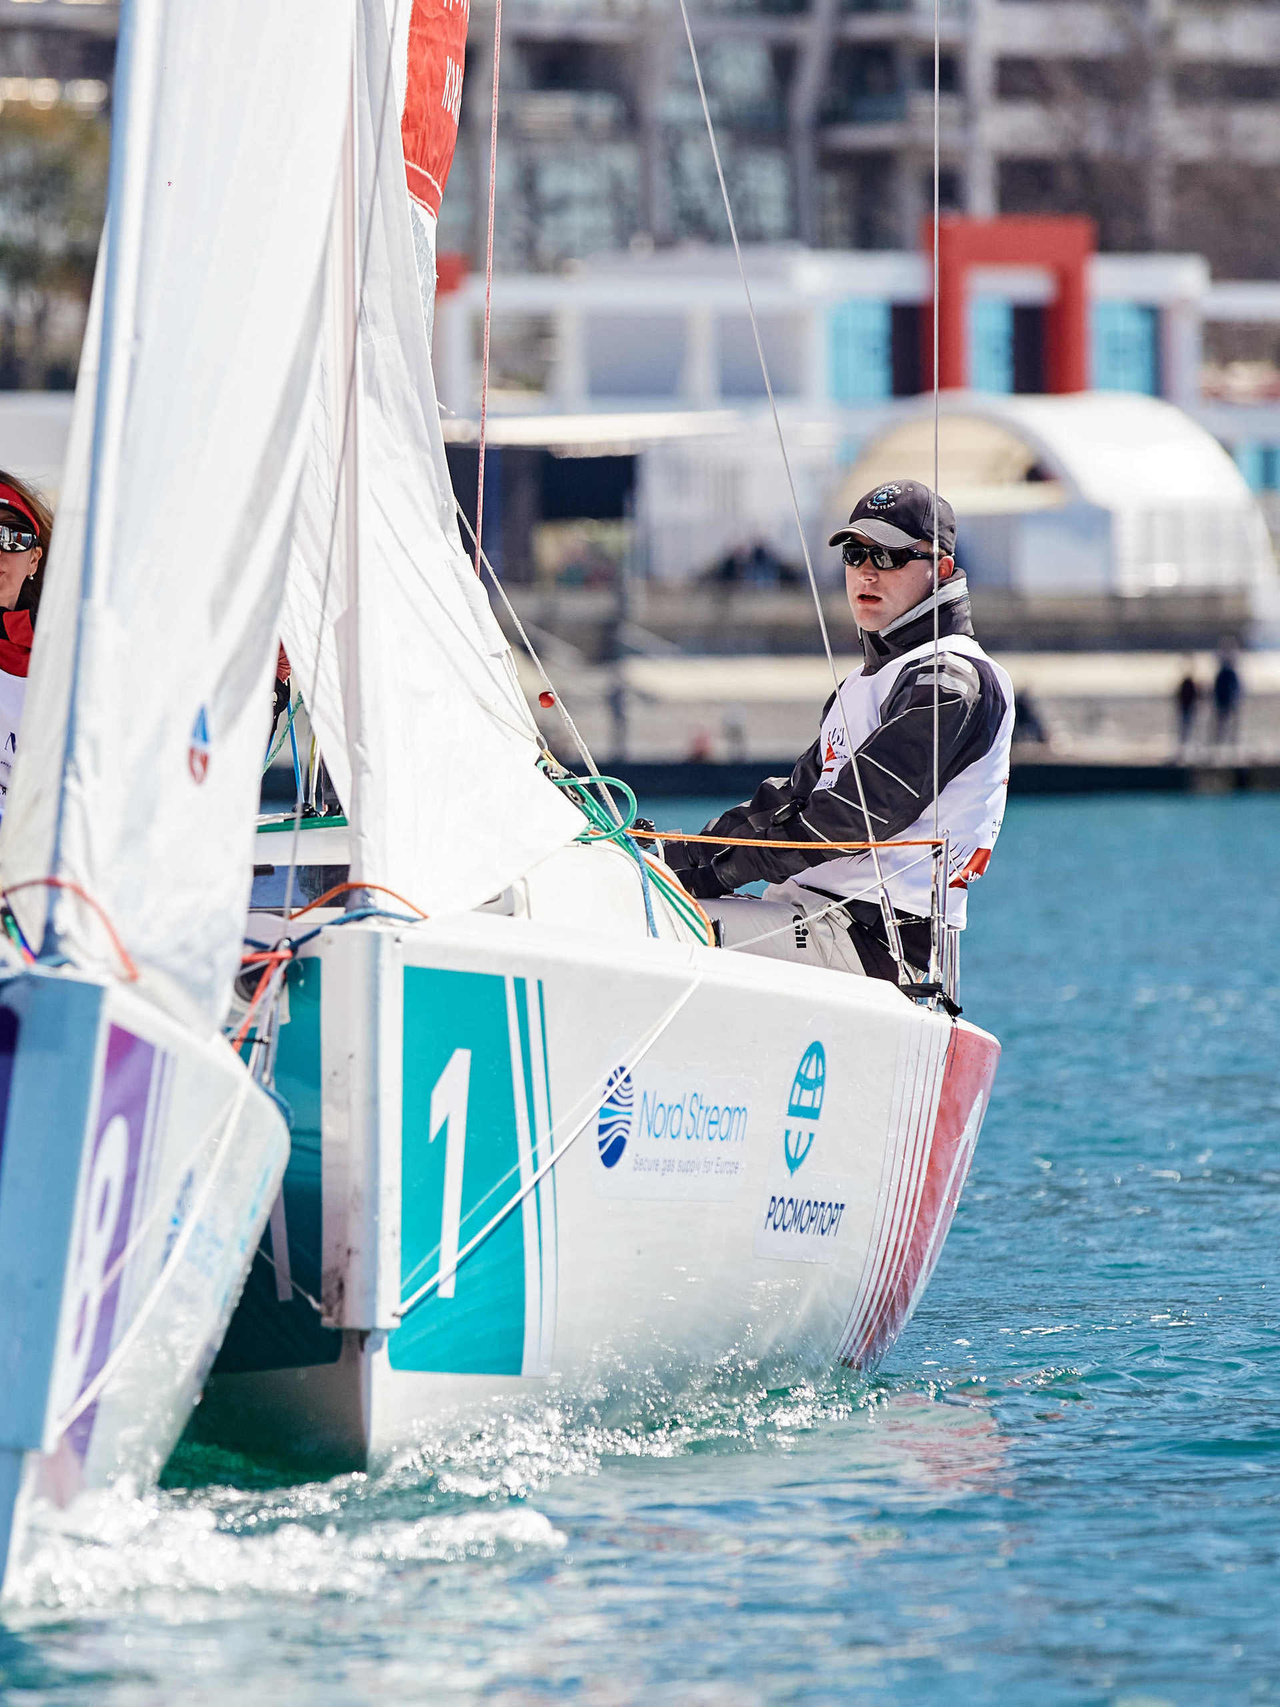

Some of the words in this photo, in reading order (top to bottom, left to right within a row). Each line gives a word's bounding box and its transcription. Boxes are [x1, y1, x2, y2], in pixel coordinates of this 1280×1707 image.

[638, 1090, 687, 1140] Nord
[685, 1092, 748, 1142] Stream
[429, 1048, 472, 1299] 1
[633, 1154, 660, 1172] Secure
[661, 1159, 676, 1176] gas
[677, 1157, 701, 1178] supply
[702, 1158, 714, 1174] for
[714, 1156, 740, 1176] Europe
[764, 1195, 846, 1237] РОСМОРПОРТ
